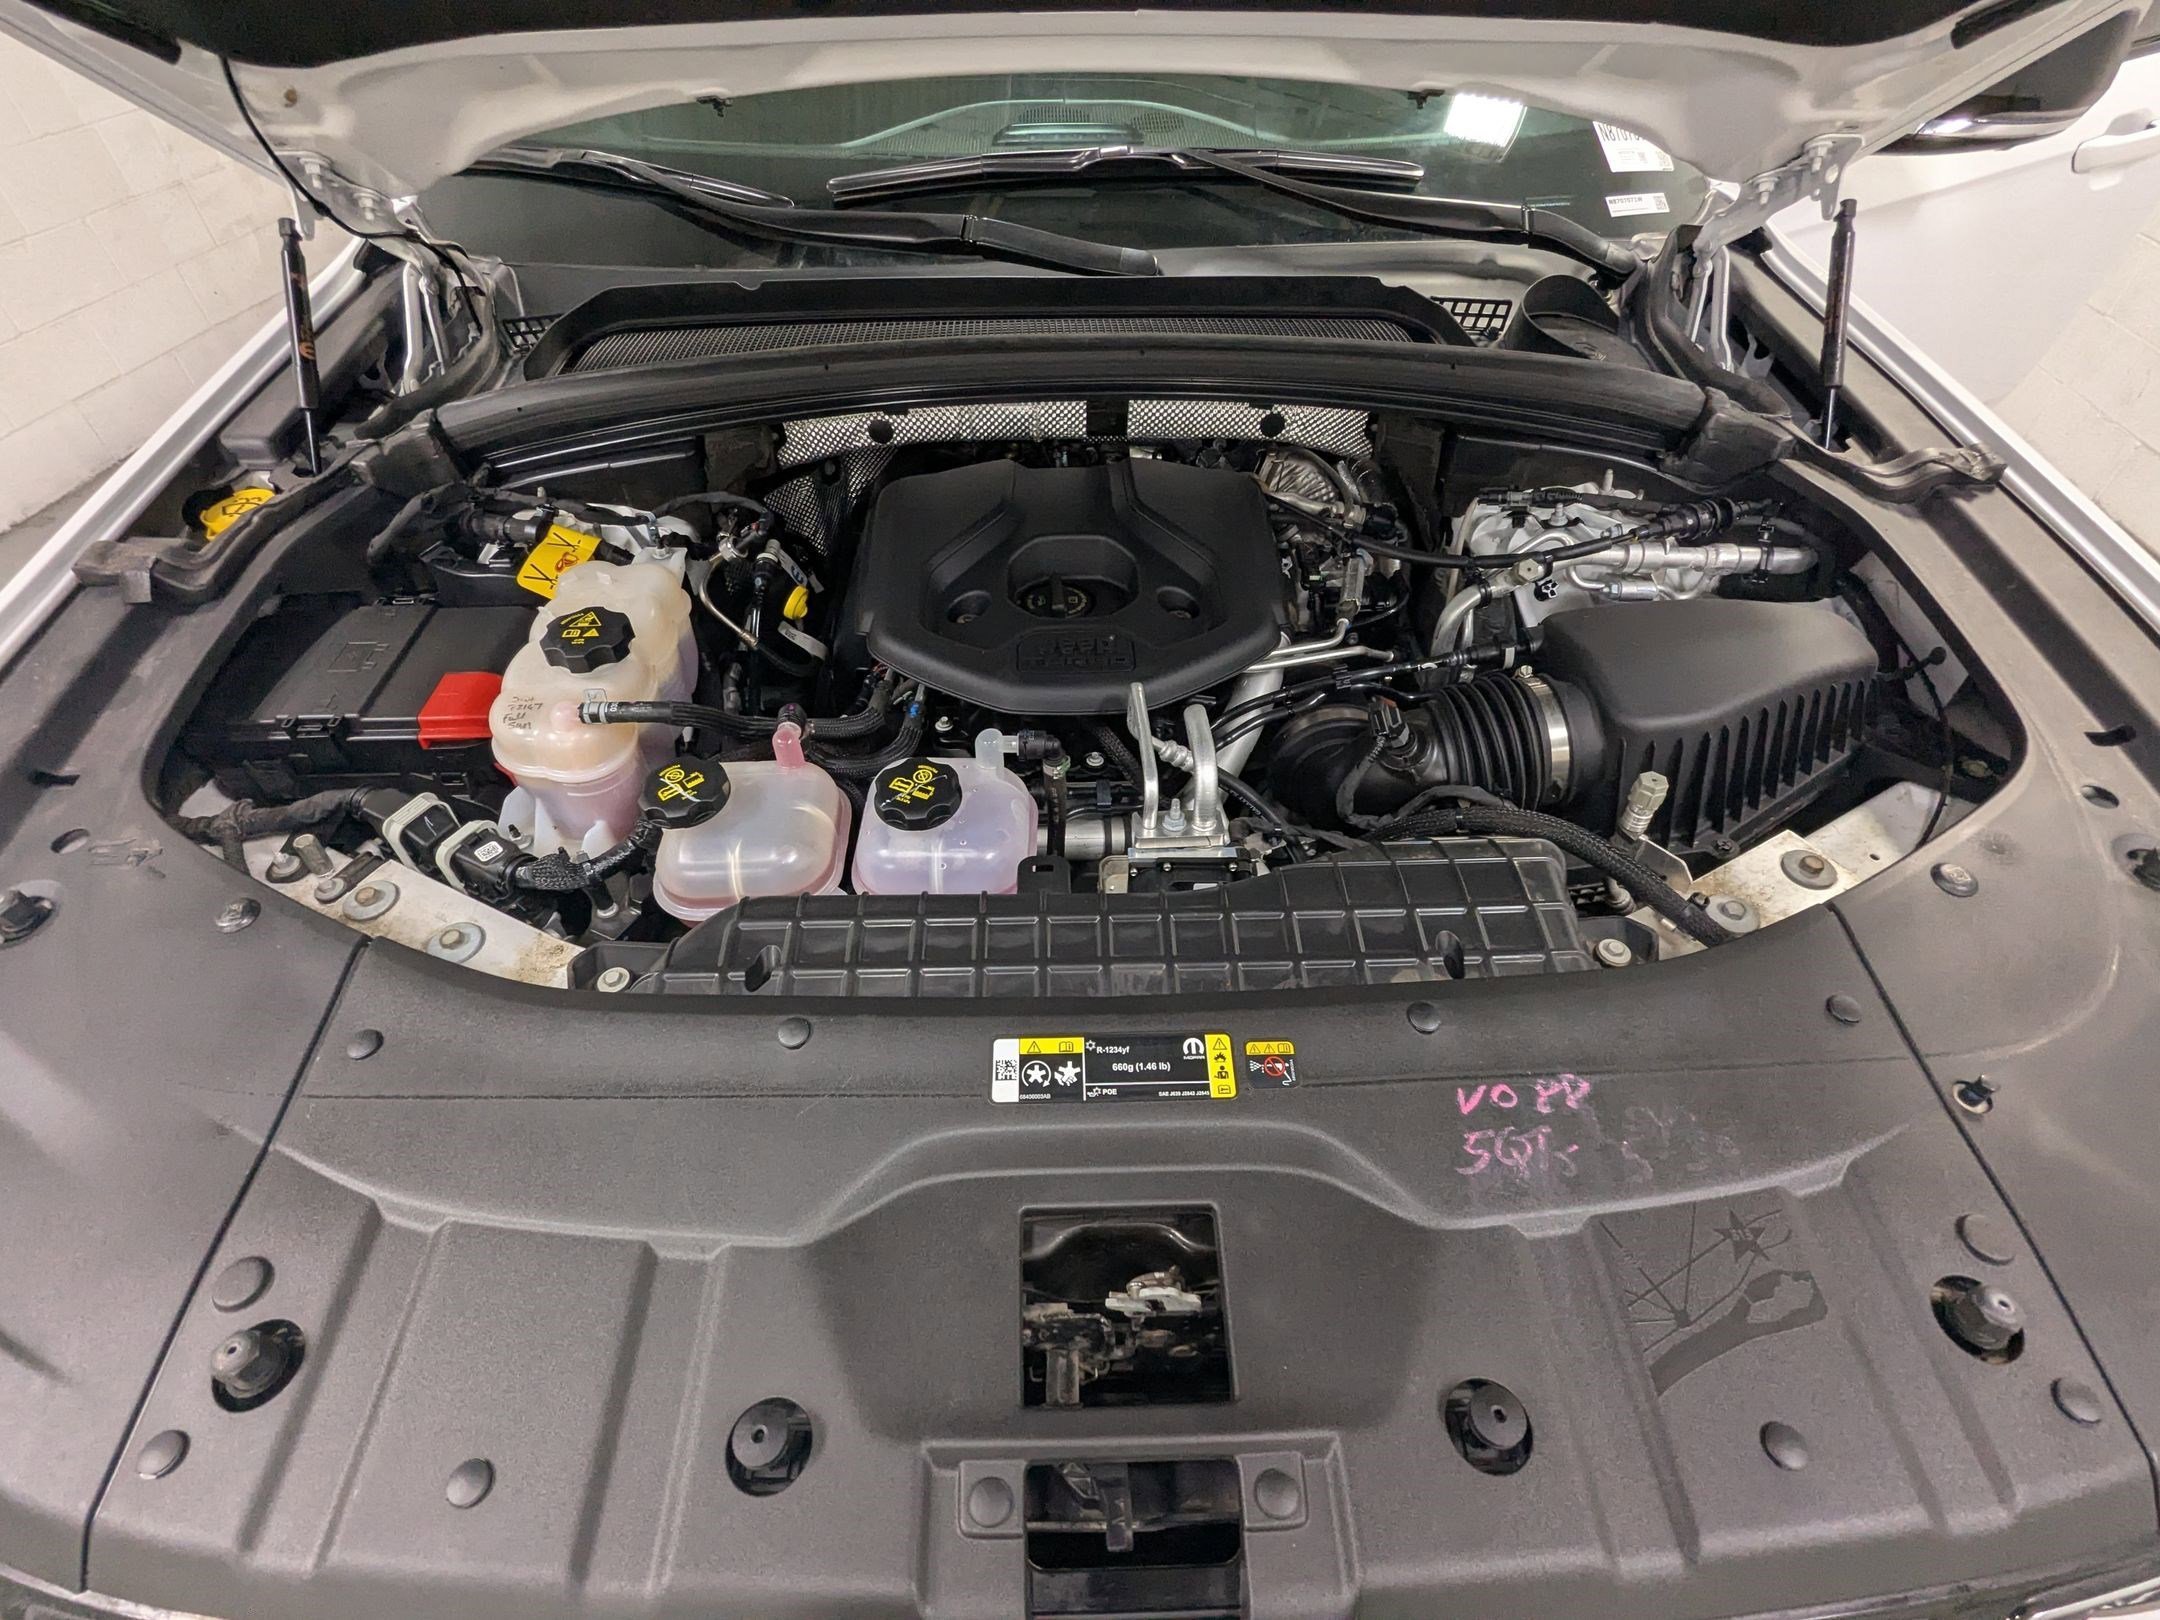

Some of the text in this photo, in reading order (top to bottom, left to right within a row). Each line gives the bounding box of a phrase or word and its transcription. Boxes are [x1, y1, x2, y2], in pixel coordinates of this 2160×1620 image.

[1096, 1046, 1130, 1054] R-1234yf
[1112, 1061, 1171, 1073] 660g (1.46 lb)
